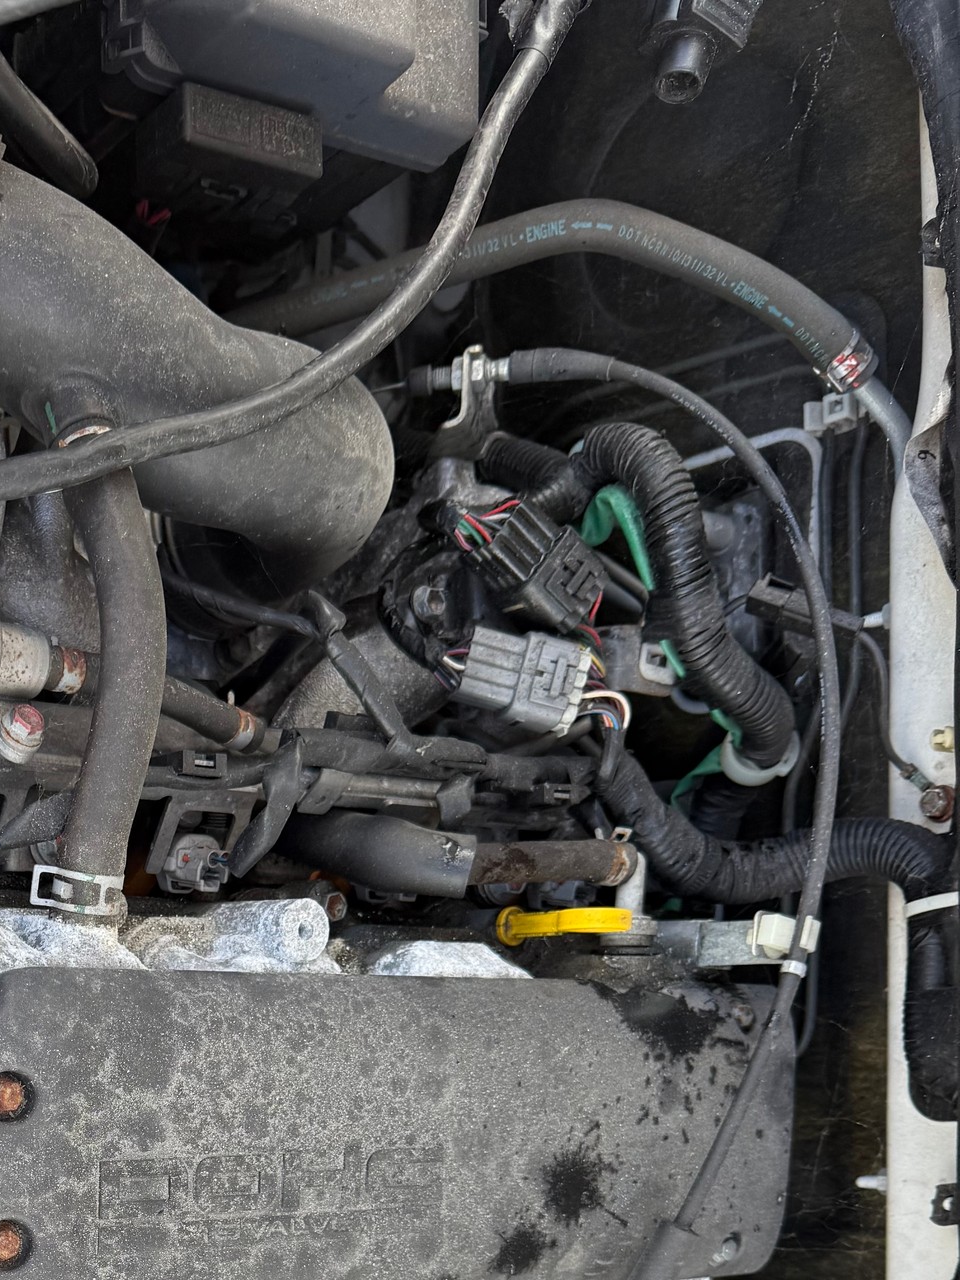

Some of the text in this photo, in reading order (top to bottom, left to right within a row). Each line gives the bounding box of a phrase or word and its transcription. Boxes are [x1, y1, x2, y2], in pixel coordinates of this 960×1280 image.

[524, 219, 567, 243] ENGINE
[732, 278, 769, 311] ENGINE
[98, 1144, 443, 1220] DOHC
